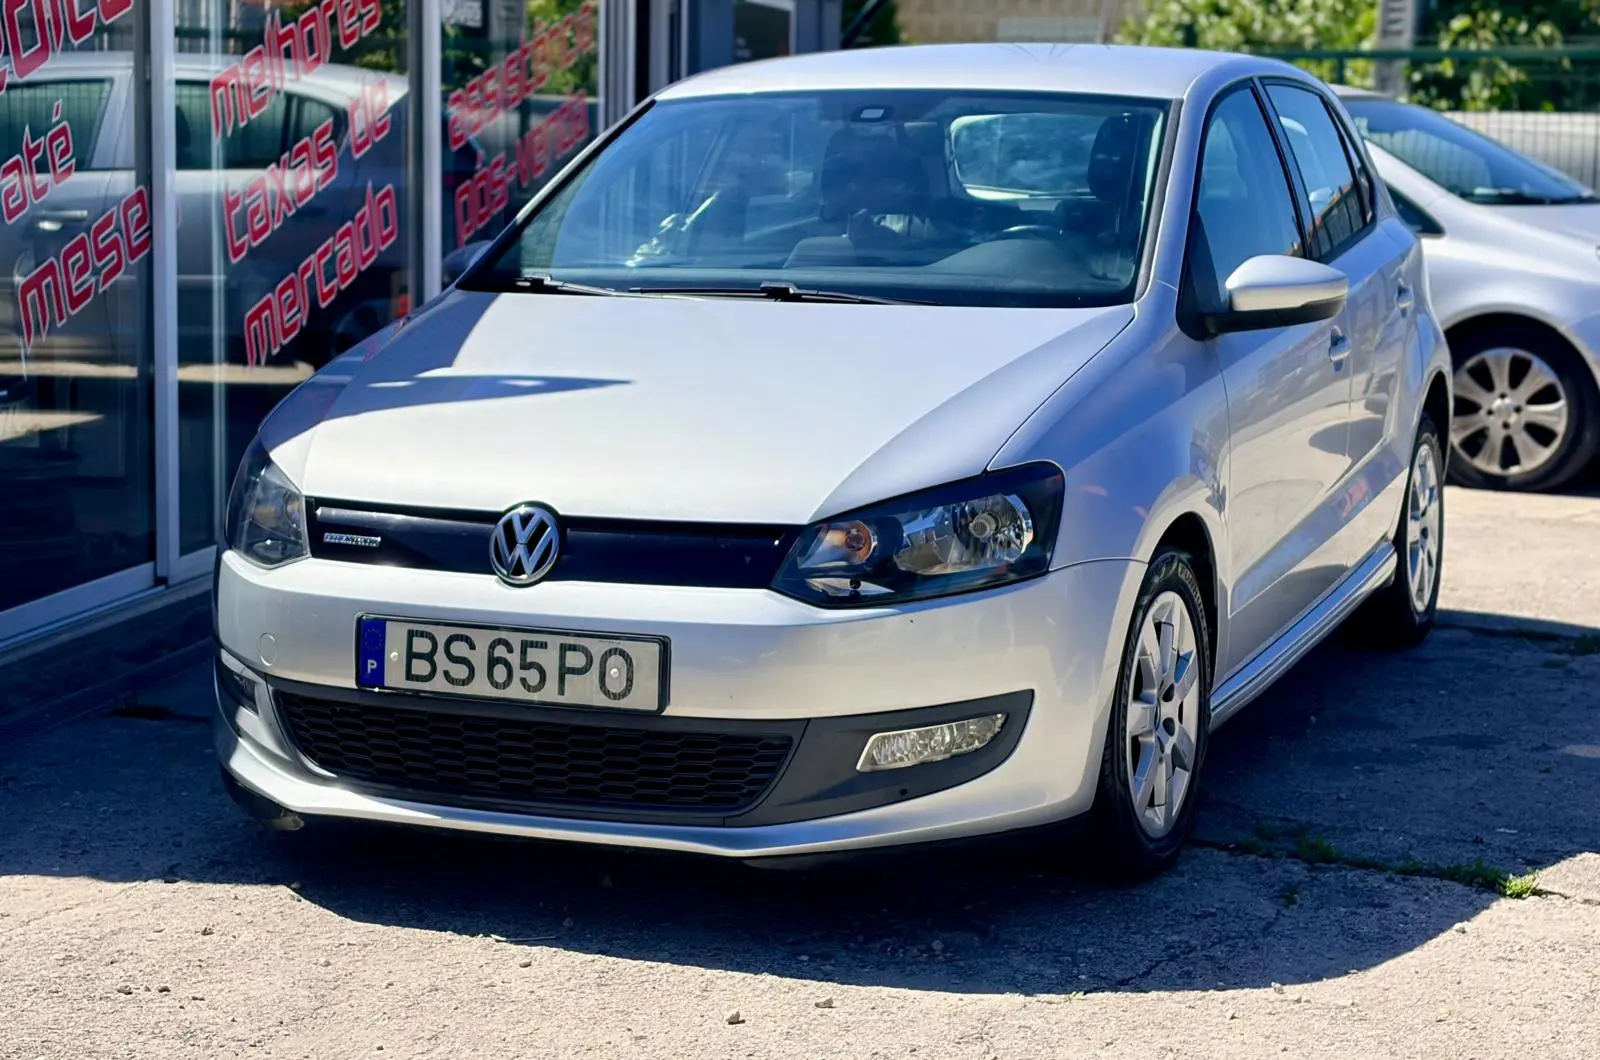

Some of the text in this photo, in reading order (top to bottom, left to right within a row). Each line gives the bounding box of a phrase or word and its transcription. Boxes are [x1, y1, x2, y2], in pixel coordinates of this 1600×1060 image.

[210, 0, 382, 141] melhores
[0, 98, 77, 225] até
[223, 74, 392, 264] taxas de
[18, 184, 152, 357] mese
[244, 179, 399, 370] mercado
[366, 659, 379, 674] P
